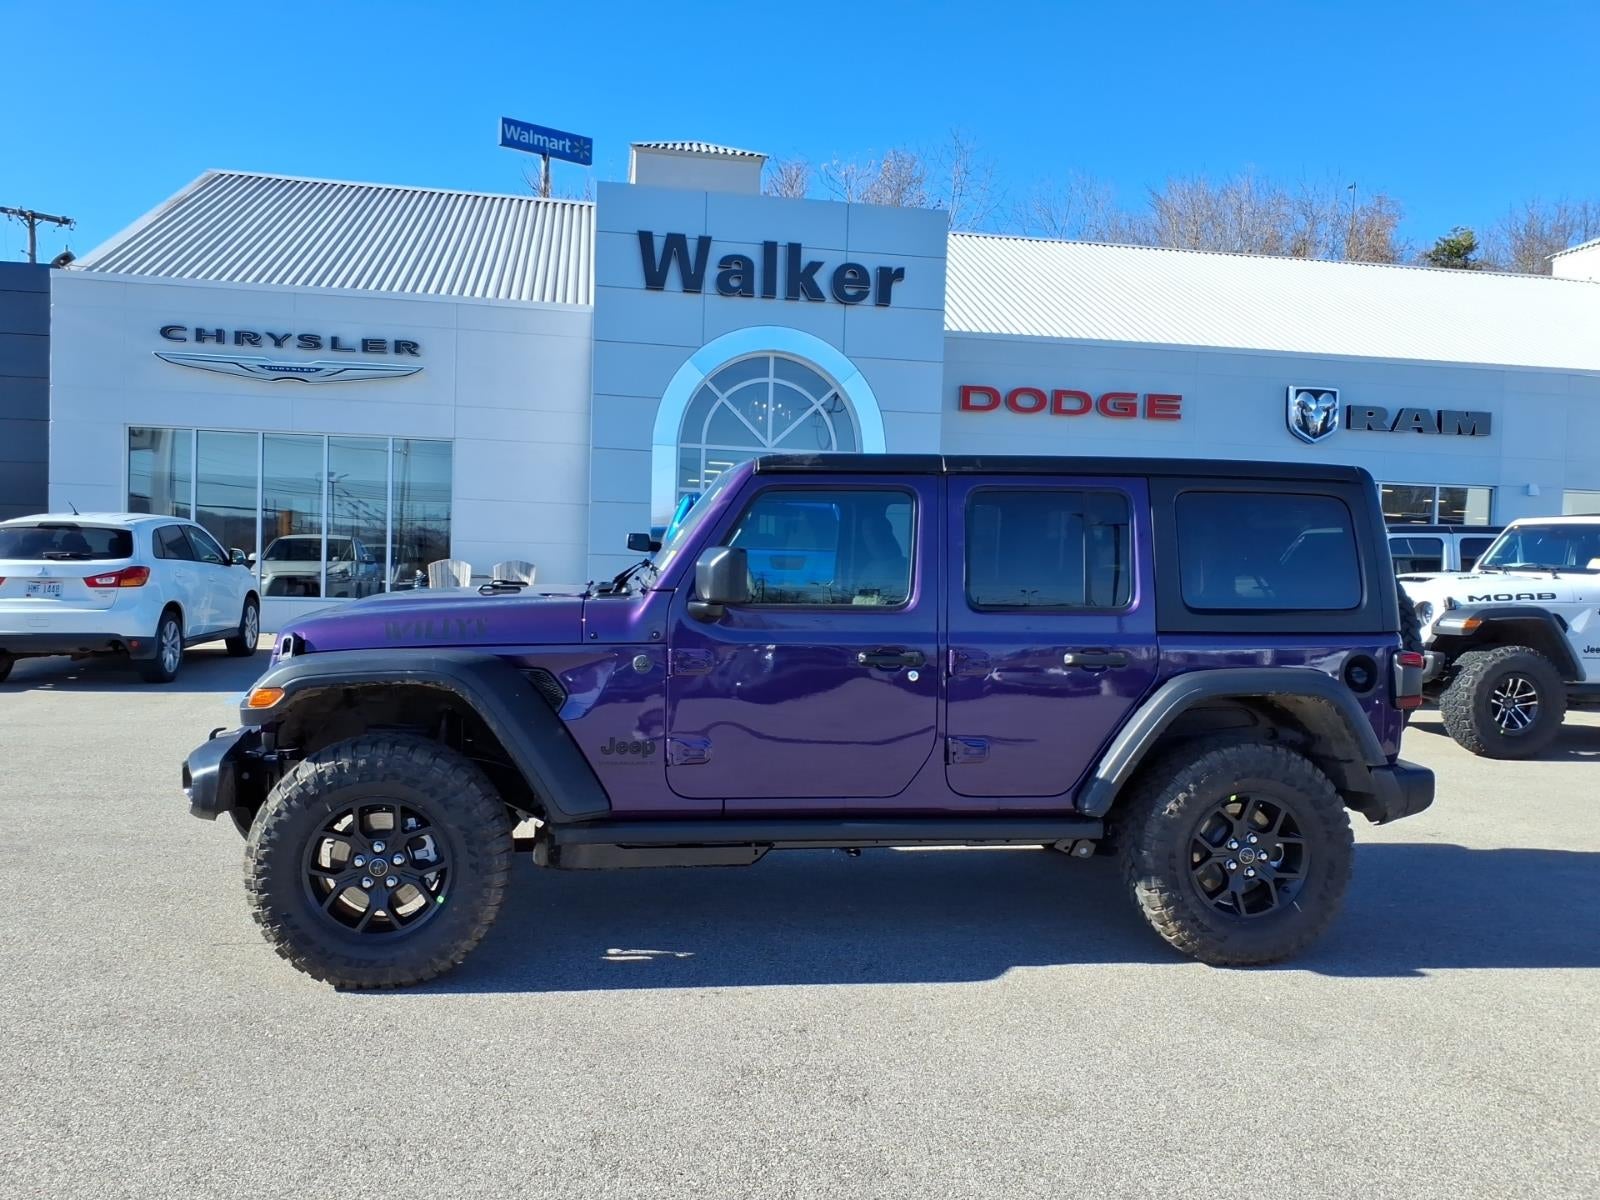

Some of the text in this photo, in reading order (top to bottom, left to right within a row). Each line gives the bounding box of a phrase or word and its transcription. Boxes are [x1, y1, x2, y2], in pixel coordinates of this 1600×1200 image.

[503, 123, 572, 153] Walmart
[637, 230, 905, 307] Walker
[159, 325, 421, 357] CHRYSLER
[959, 385, 1183, 420] DODGE
[1346, 404, 1492, 437] RAM
[1467, 592, 1557, 602] MOAB
[600, 736, 656, 758] Jeep
